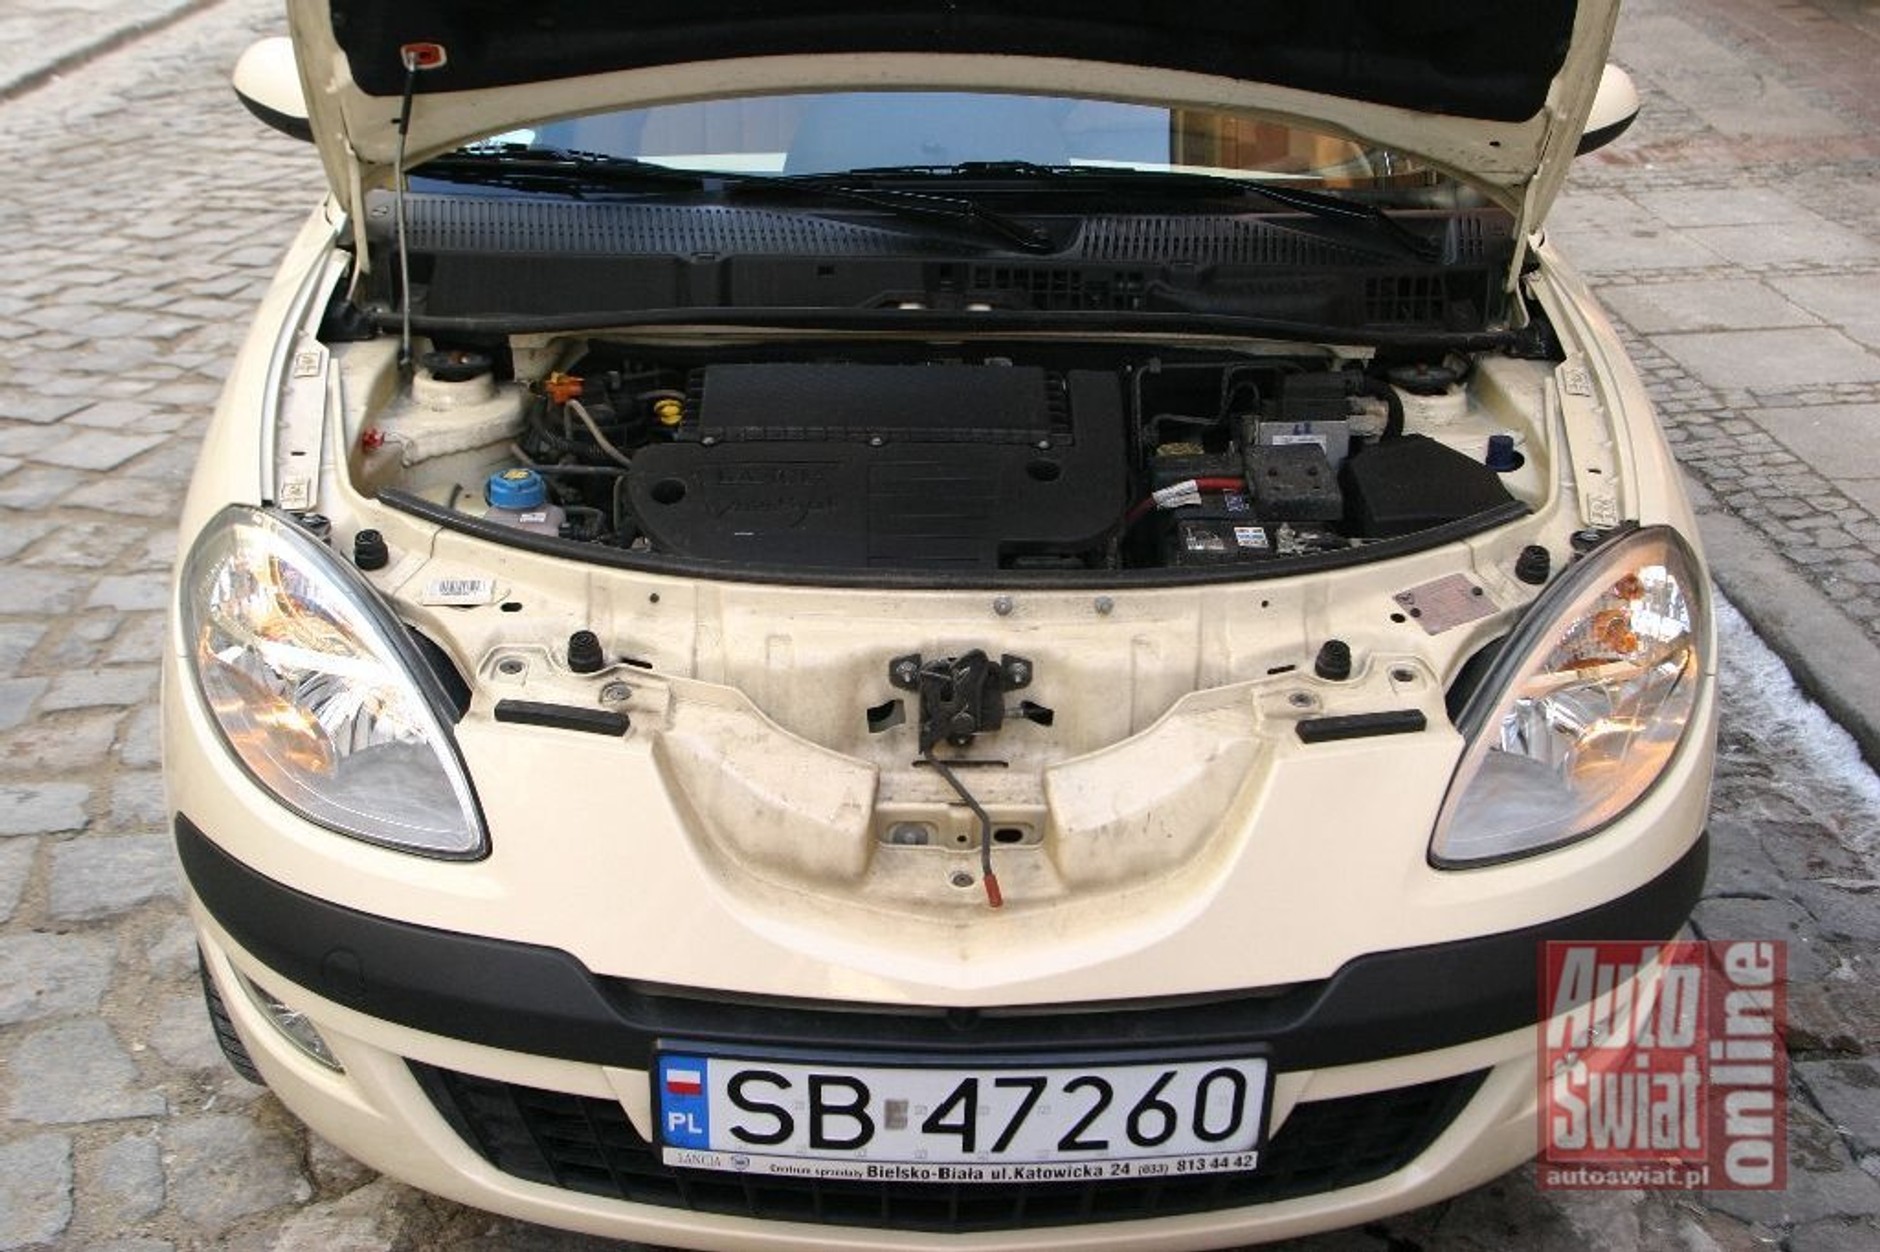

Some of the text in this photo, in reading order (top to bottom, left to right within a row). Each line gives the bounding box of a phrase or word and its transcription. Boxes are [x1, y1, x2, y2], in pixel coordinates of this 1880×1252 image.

[668, 1111, 703, 1134] PL
[727, 1067, 1247, 1153] SB 47260
[866, 1164, 984, 1180] Bielsko-Biała
[1110, 1163, 1130, 1176] 24
[1176, 1158, 1206, 1173] 813
[1233, 1154, 1253, 1168] 42
